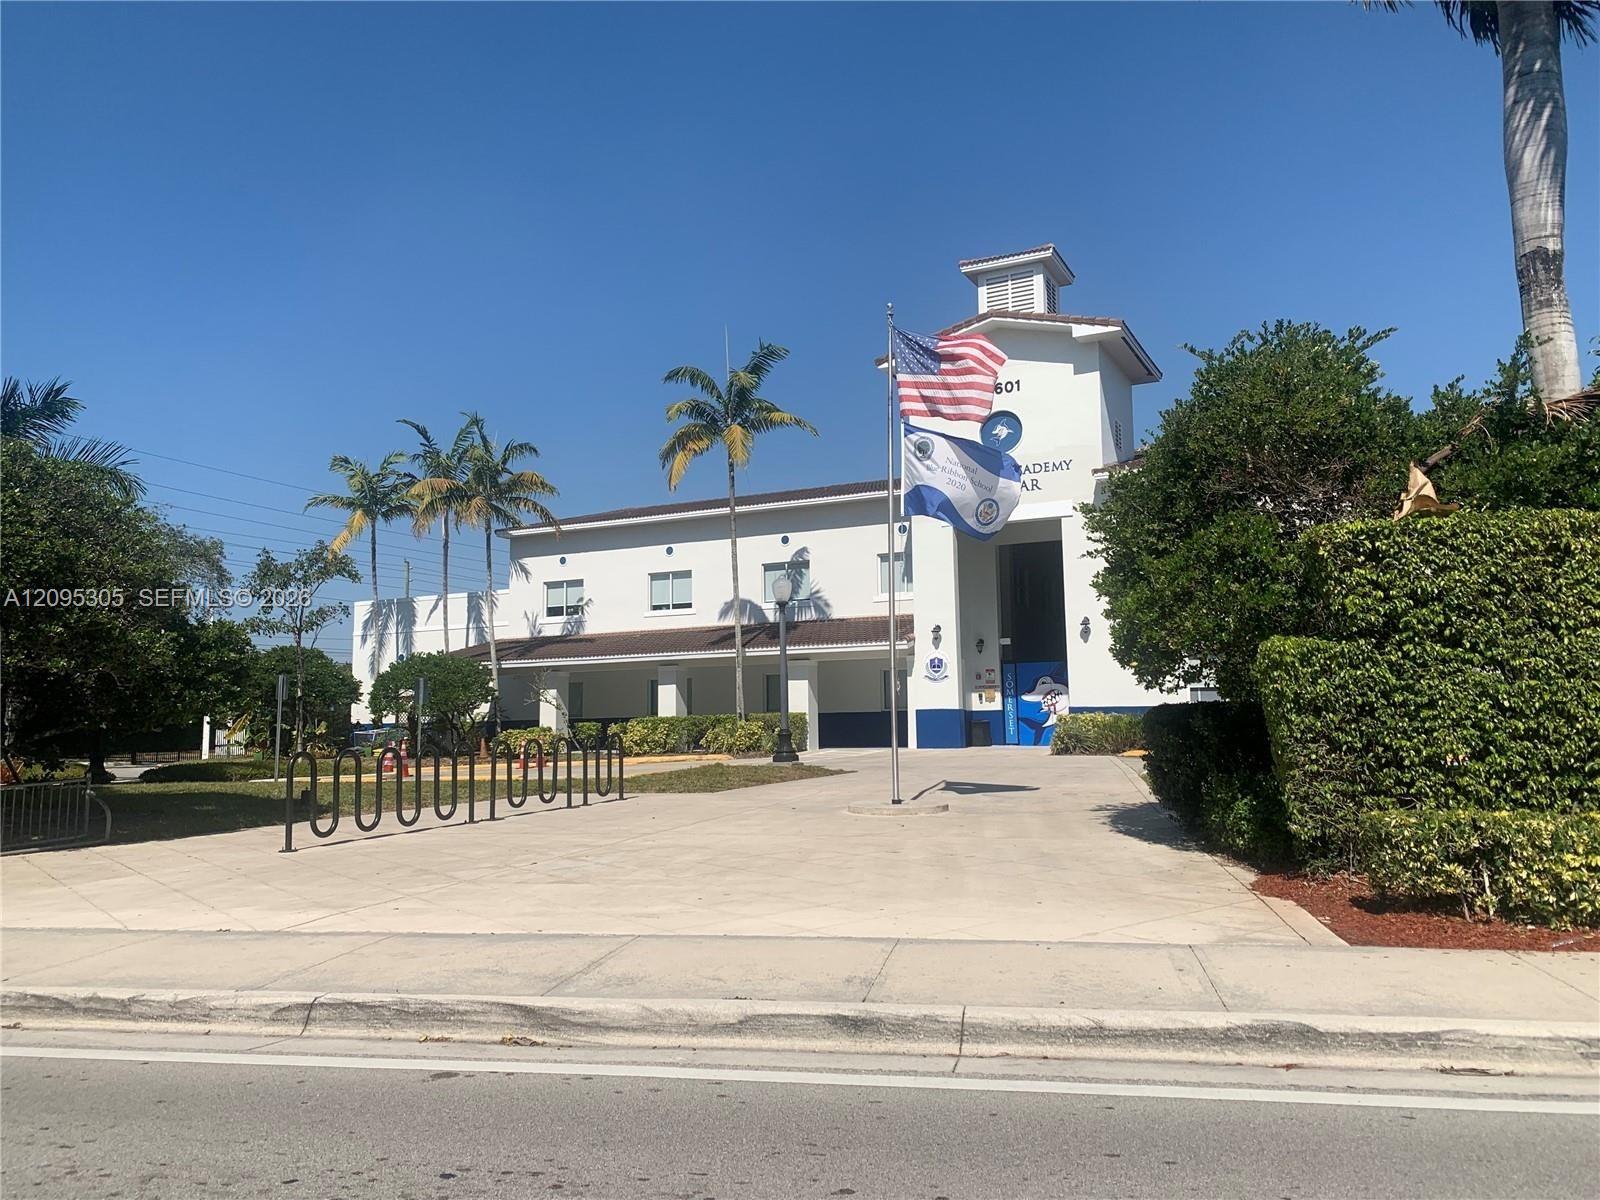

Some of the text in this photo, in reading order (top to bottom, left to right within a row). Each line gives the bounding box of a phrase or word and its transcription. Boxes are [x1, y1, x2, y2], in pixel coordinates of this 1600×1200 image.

[945, 456, 978, 475] National
[941, 465, 968, 482] Ribbon
[970, 477, 994, 492] School
[945, 477, 967, 491] 2020
[1005, 672, 1016, 735] SOMERSET
